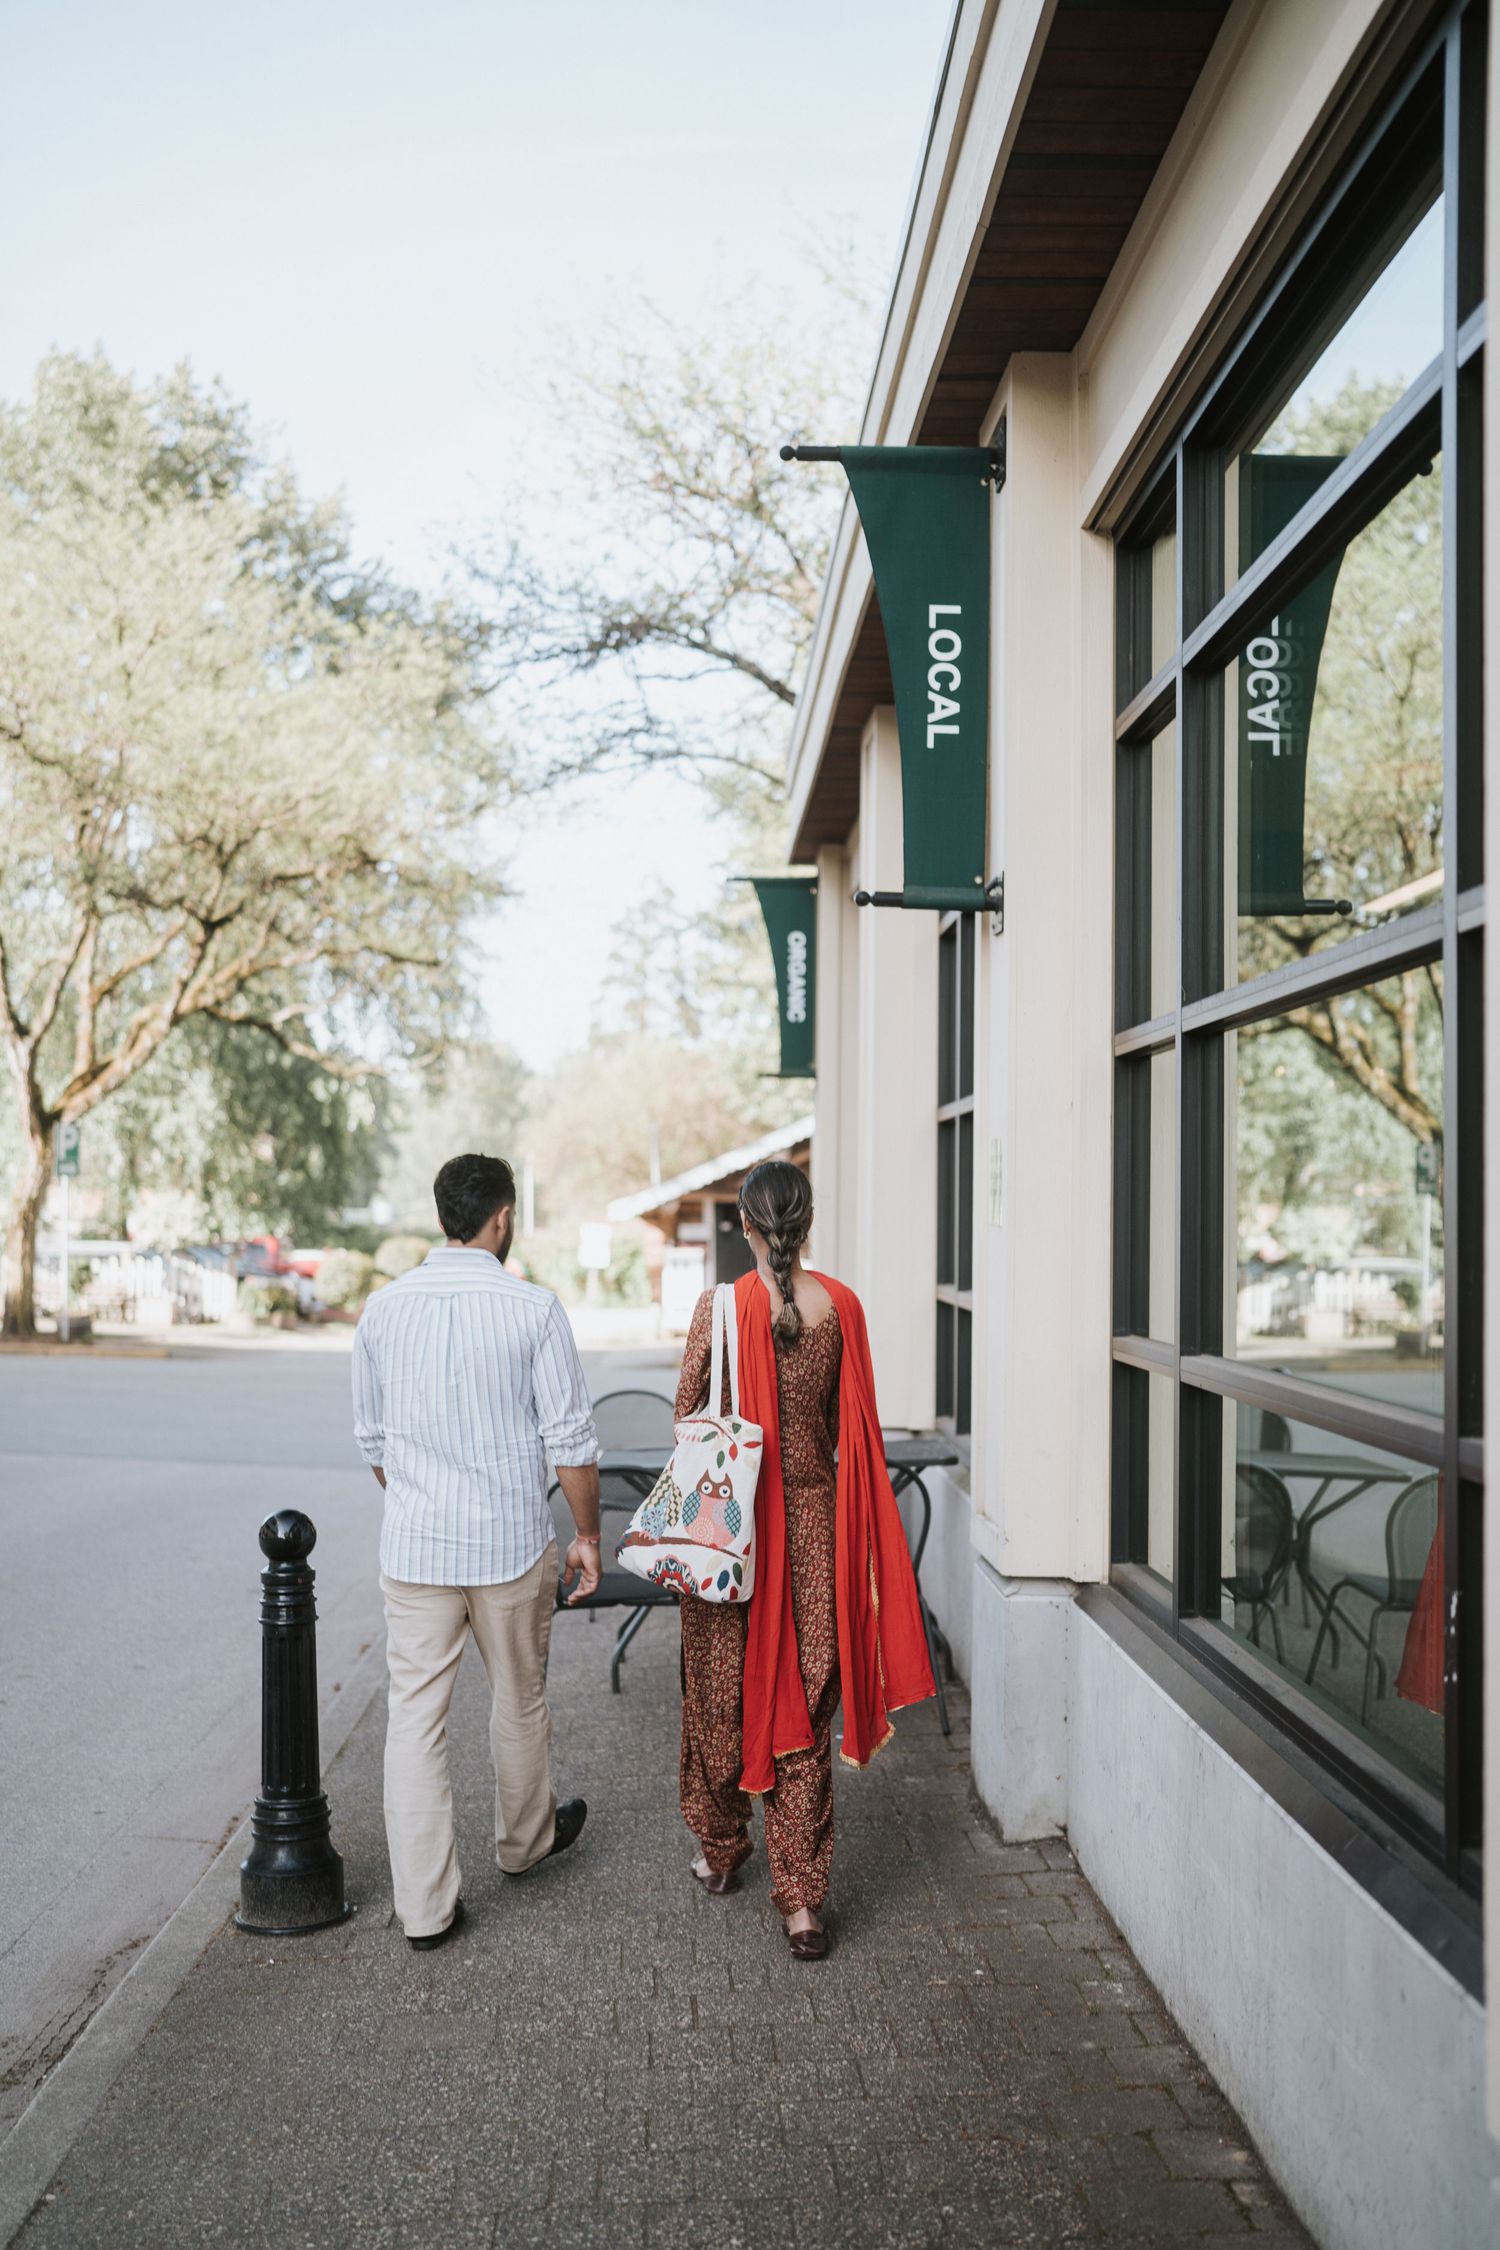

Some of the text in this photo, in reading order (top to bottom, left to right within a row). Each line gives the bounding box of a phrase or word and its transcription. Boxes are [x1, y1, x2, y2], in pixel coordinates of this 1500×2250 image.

[926, 604, 962, 749] LOCAL
[786, 930, 807, 1023] ORGANIC
[59, 1126, 78, 1160] P
